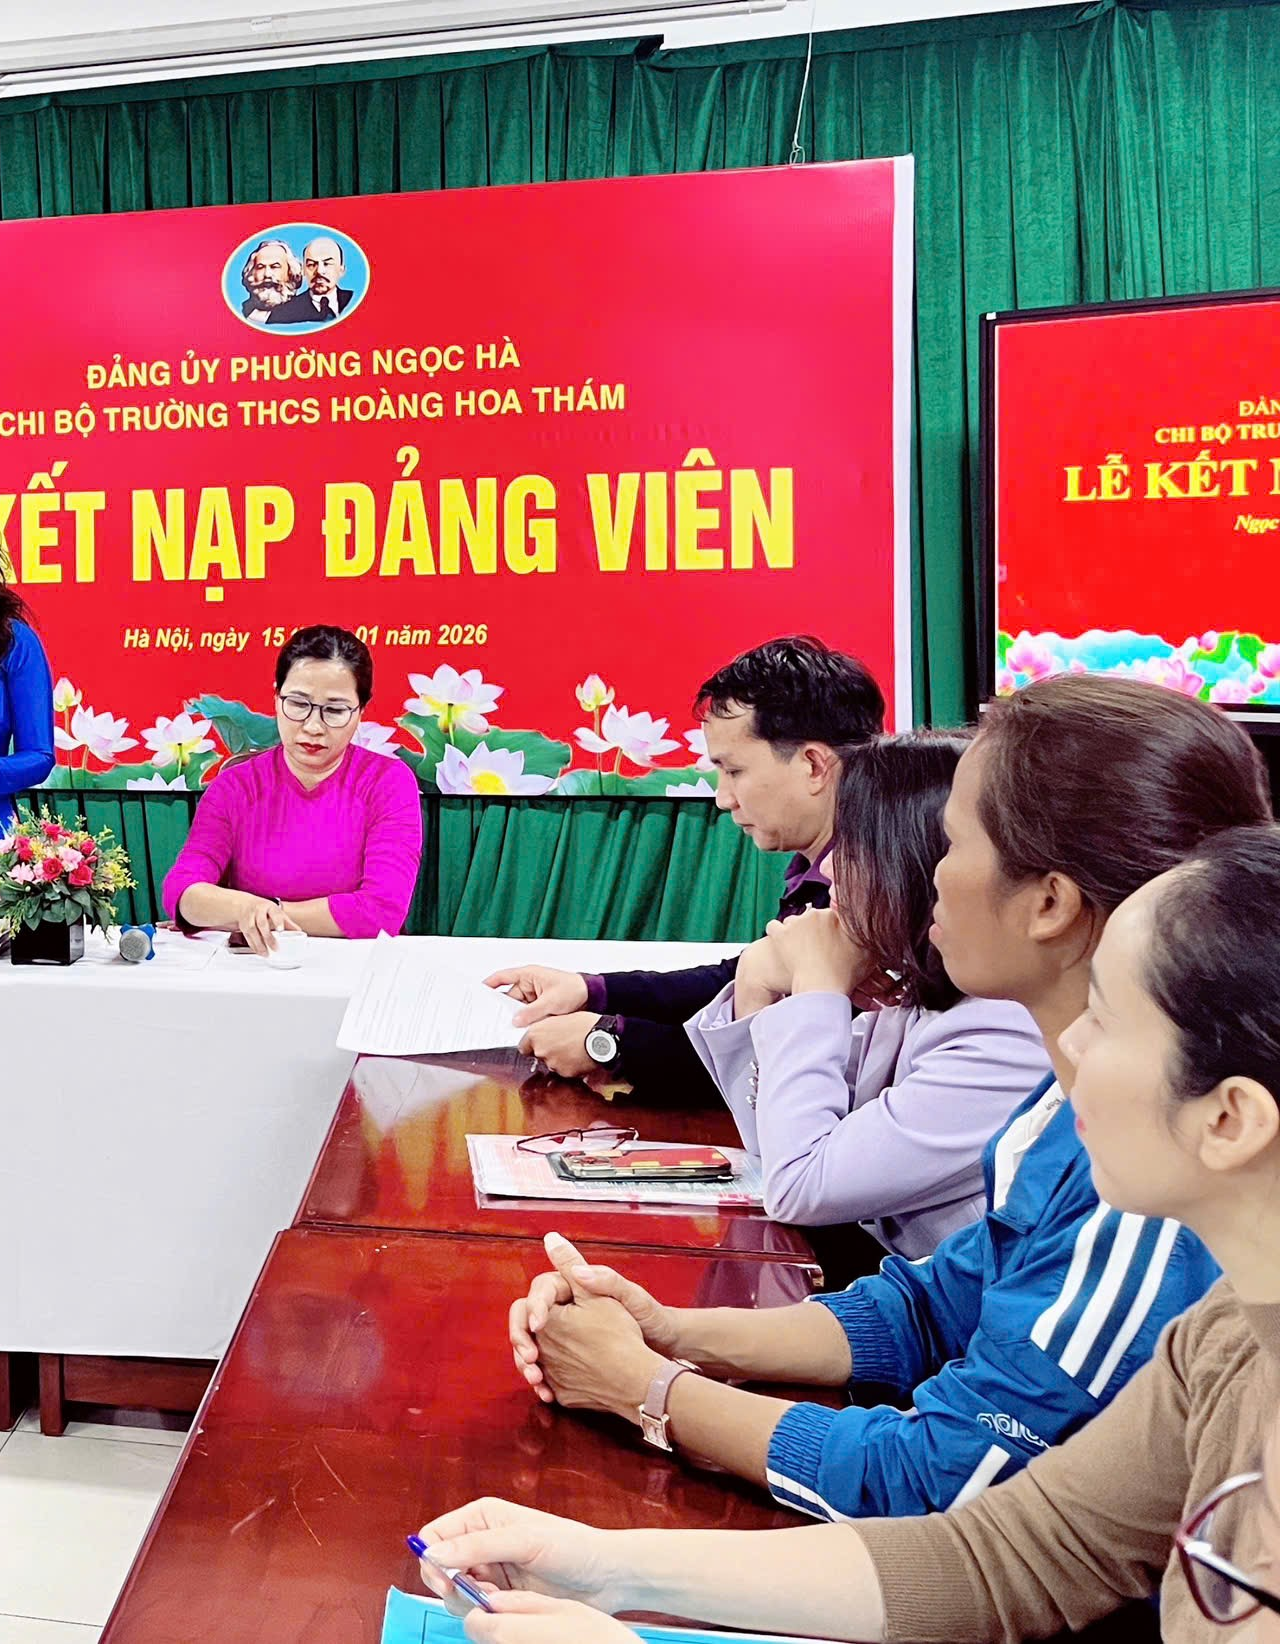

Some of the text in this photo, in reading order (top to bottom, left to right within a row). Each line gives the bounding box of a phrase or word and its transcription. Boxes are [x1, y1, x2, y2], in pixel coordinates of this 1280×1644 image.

[86, 336, 521, 390] ĐẢNG ỦY PHƯỜNG NGỌC HÀ
[54, 402, 96, 438] BỘ
[102, 398, 229, 432] TRƯỜNG
[237, 398, 321, 426] THCS
[331, 388, 444, 423] HOÀNG
[455, 388, 523, 417] HOA
[531, 378, 625, 413] THÁM
[1154, 427, 1196, 444] CHI
[1201, 423, 1232, 445] BỘ
[1063, 454, 1131, 502] LỄ
[1143, 449, 1258, 499] KẾT
[131, 485, 295, 603] NẠP
[320, 445, 557, 578] ĐẢNG
[586, 447, 794, 572] VIÊN
[123, 627, 150, 649] Hà
[155, 627, 194, 653] Nội,
[200, 627, 251, 653] ngày
[262, 626, 286, 647] 15
[355, 625, 380, 646] 01
[385, 624, 431, 646] năm
[437, 623, 488, 645] 2026
